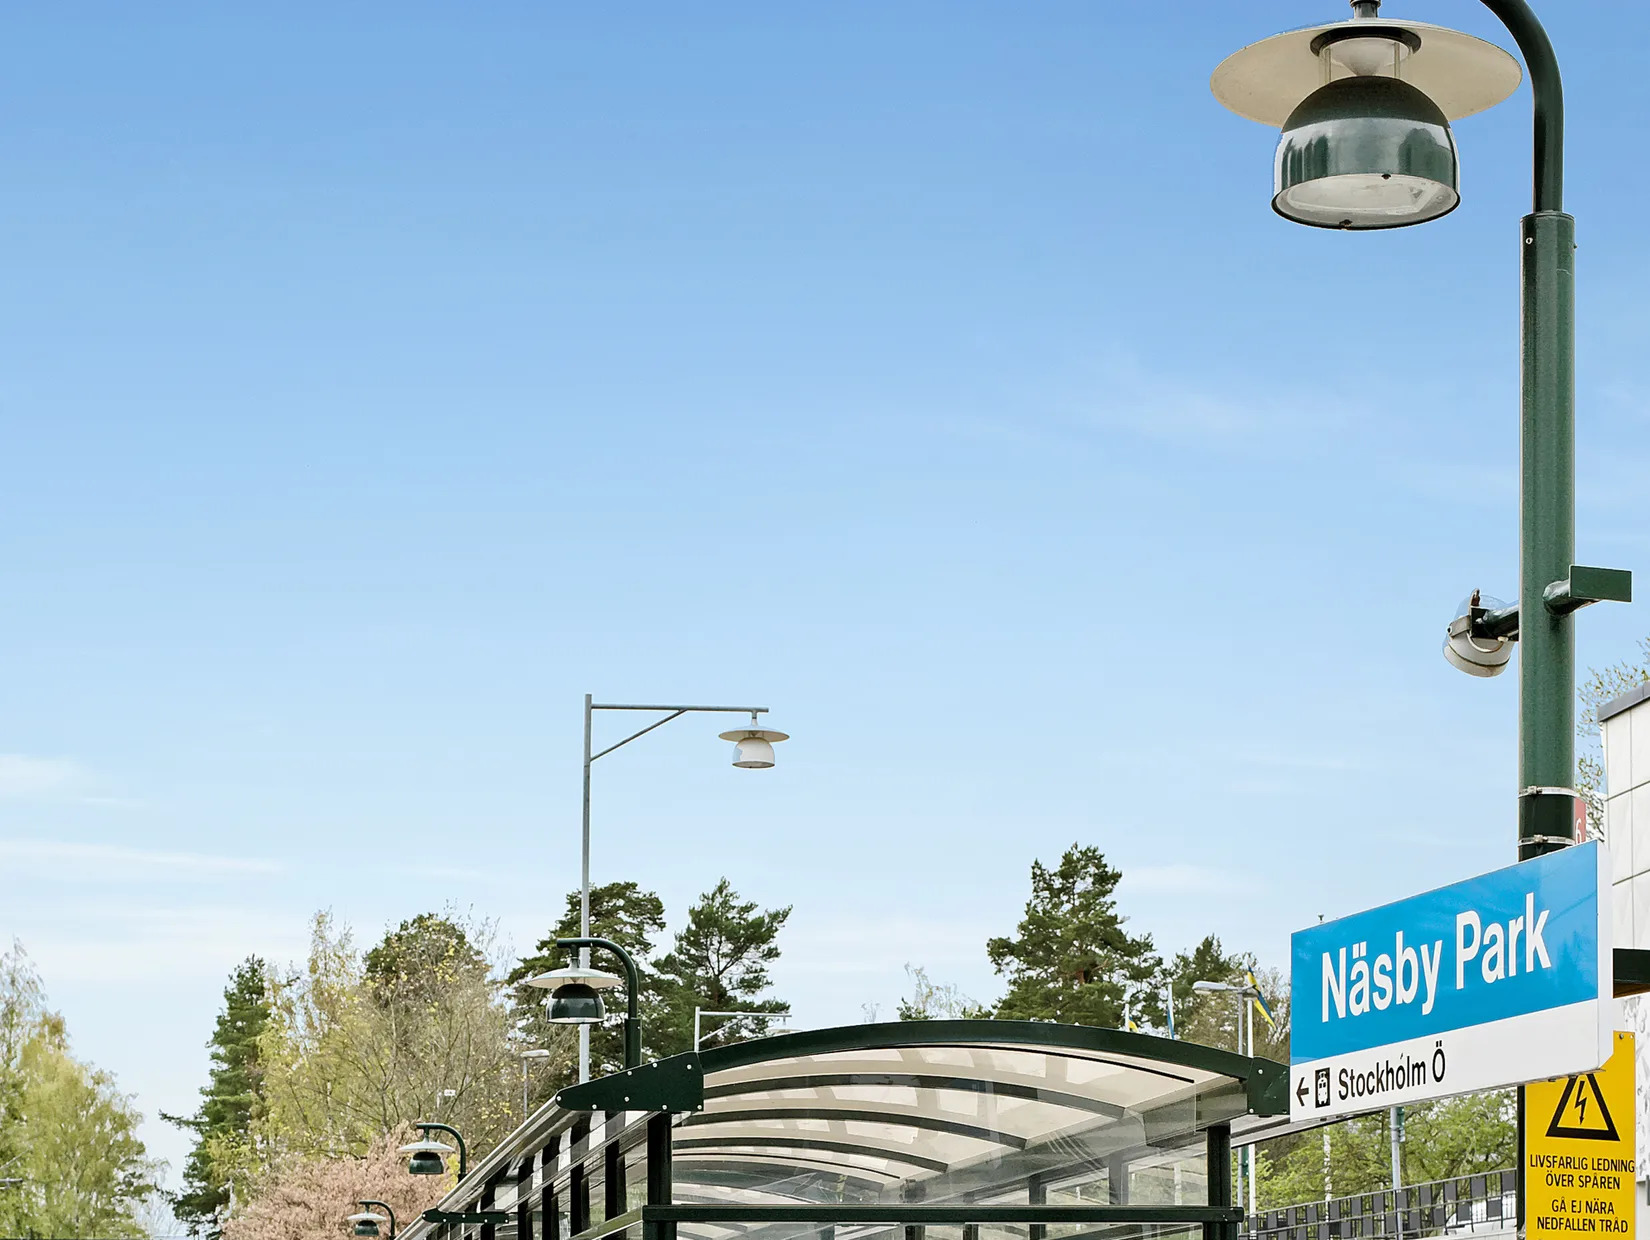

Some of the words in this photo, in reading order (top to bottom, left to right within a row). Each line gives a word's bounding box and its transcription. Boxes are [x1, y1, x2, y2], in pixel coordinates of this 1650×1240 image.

[1322, 931, 1443, 1023] Näsby
[1456, 892, 1552, 990] Park
[1432, 1040, 1446, 1083] Ö
[1530, 1154, 1588, 1170] LIVSFARLIG
[1591, 1157, 1635, 1173] LEDNING
[1545, 1170, 1574, 1187] ÖVER
[1578, 1172, 1621, 1190] SPÅREN
[1551, 1196, 1567, 1213] GÅ
[1571, 1199, 1582, 1214] EJ
[1585, 1198, 1615, 1215] NÄRA
[1537, 1216, 1596, 1232] NEDFALLEN
[1599, 1216, 1628, 1233] TRÅD
